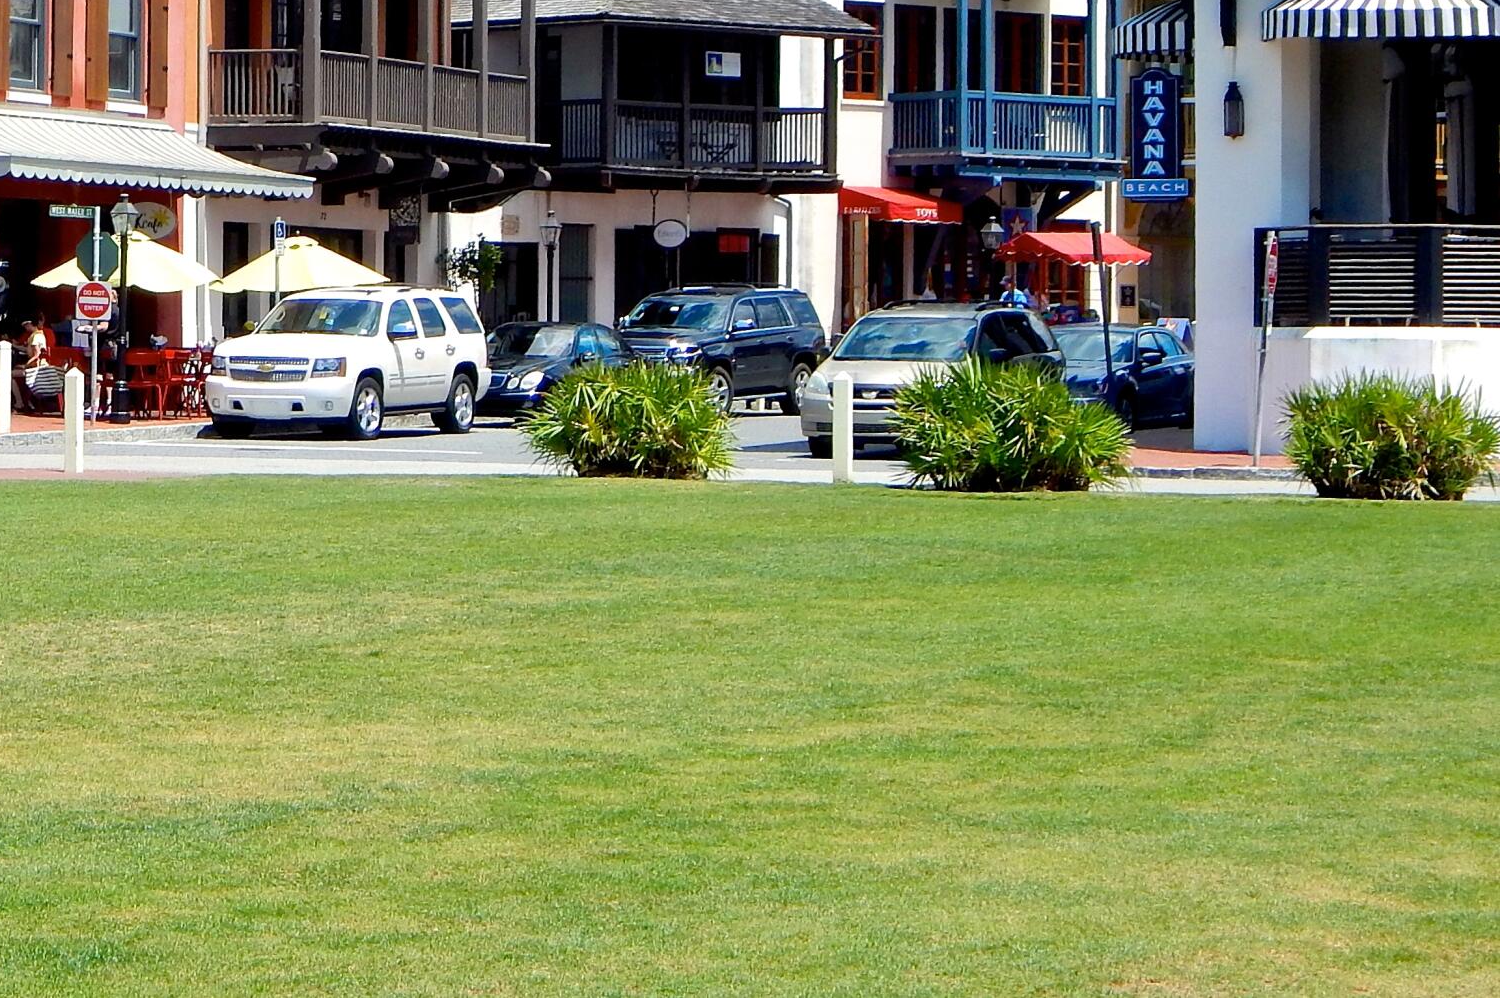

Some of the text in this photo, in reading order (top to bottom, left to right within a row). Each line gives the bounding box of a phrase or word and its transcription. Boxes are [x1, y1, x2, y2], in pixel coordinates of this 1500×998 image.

[1141, 80, 1165, 175] HAVANA
[1126, 183, 1185, 192] BEACH
[51, 206, 66, 215] WEST
[915, 208, 938, 217] TOYS
